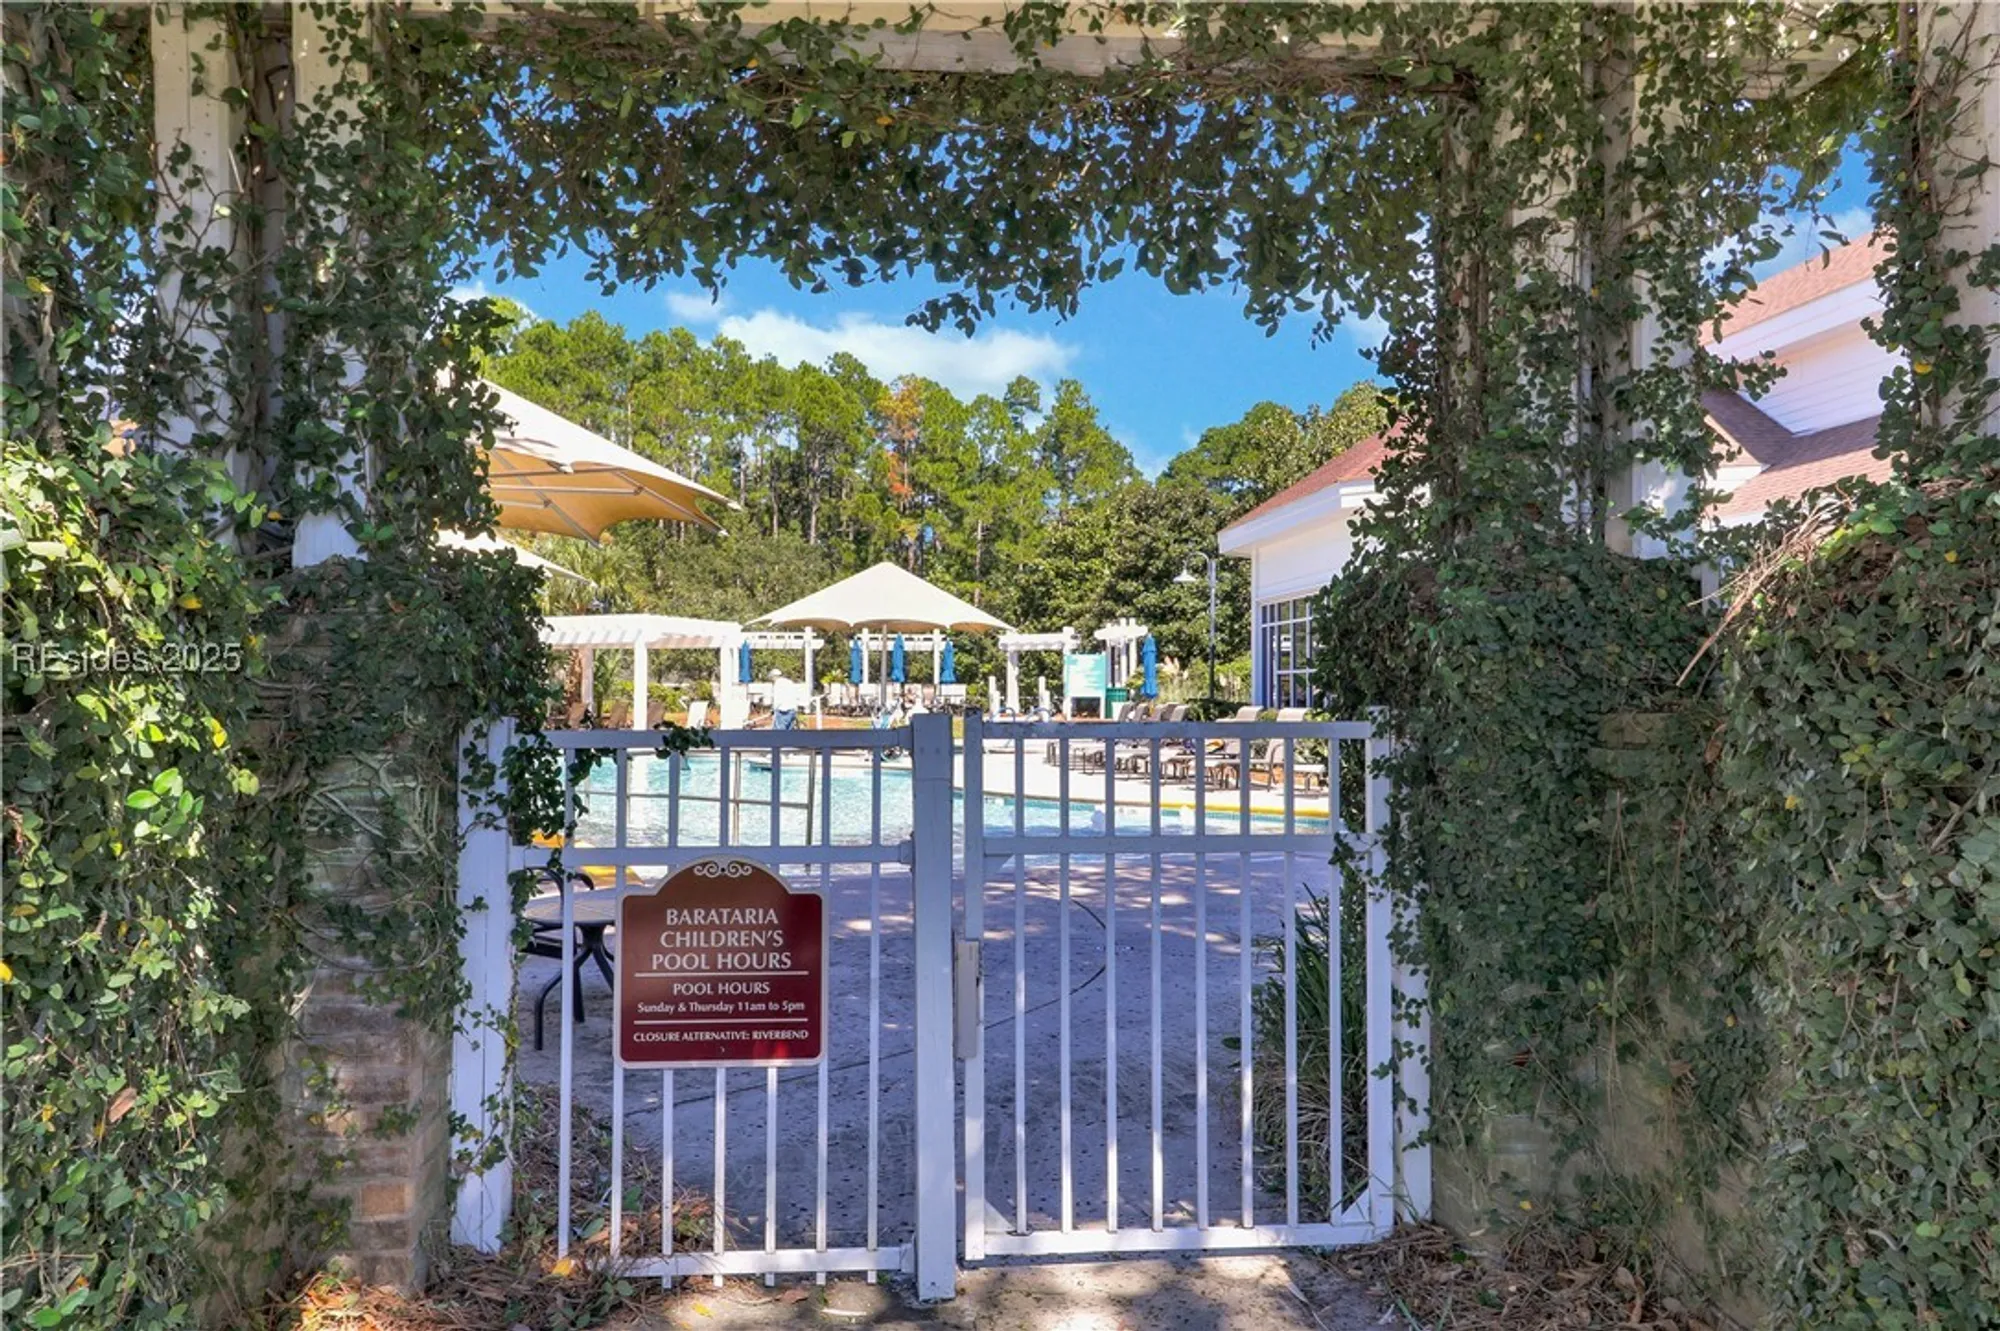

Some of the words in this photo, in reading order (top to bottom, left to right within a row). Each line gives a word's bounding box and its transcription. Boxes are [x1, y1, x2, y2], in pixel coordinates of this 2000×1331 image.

[666, 908, 779, 926] BARATARIA
[660, 929, 784, 948] CHILDREN'S
[652, 953, 710, 970] POOL
[717, 952, 792, 970] HOURS
[673, 982, 714, 996] POOL
[718, 981, 770, 995] HOURS
[637, 1001, 676, 1015] Sunday
[678, 1002, 687, 1012] &
[689, 1001, 735, 1014] Thursday
[738, 1001, 766, 1011] 11am
[768, 1001, 780, 1011] to
[782, 1000, 805, 1013] 5pm
[633, 1031, 680, 1042] CLOSURE
[682, 1030, 751, 1041] ALTERNATIVE:
[752, 1029, 809, 1040] RIVERBEND
